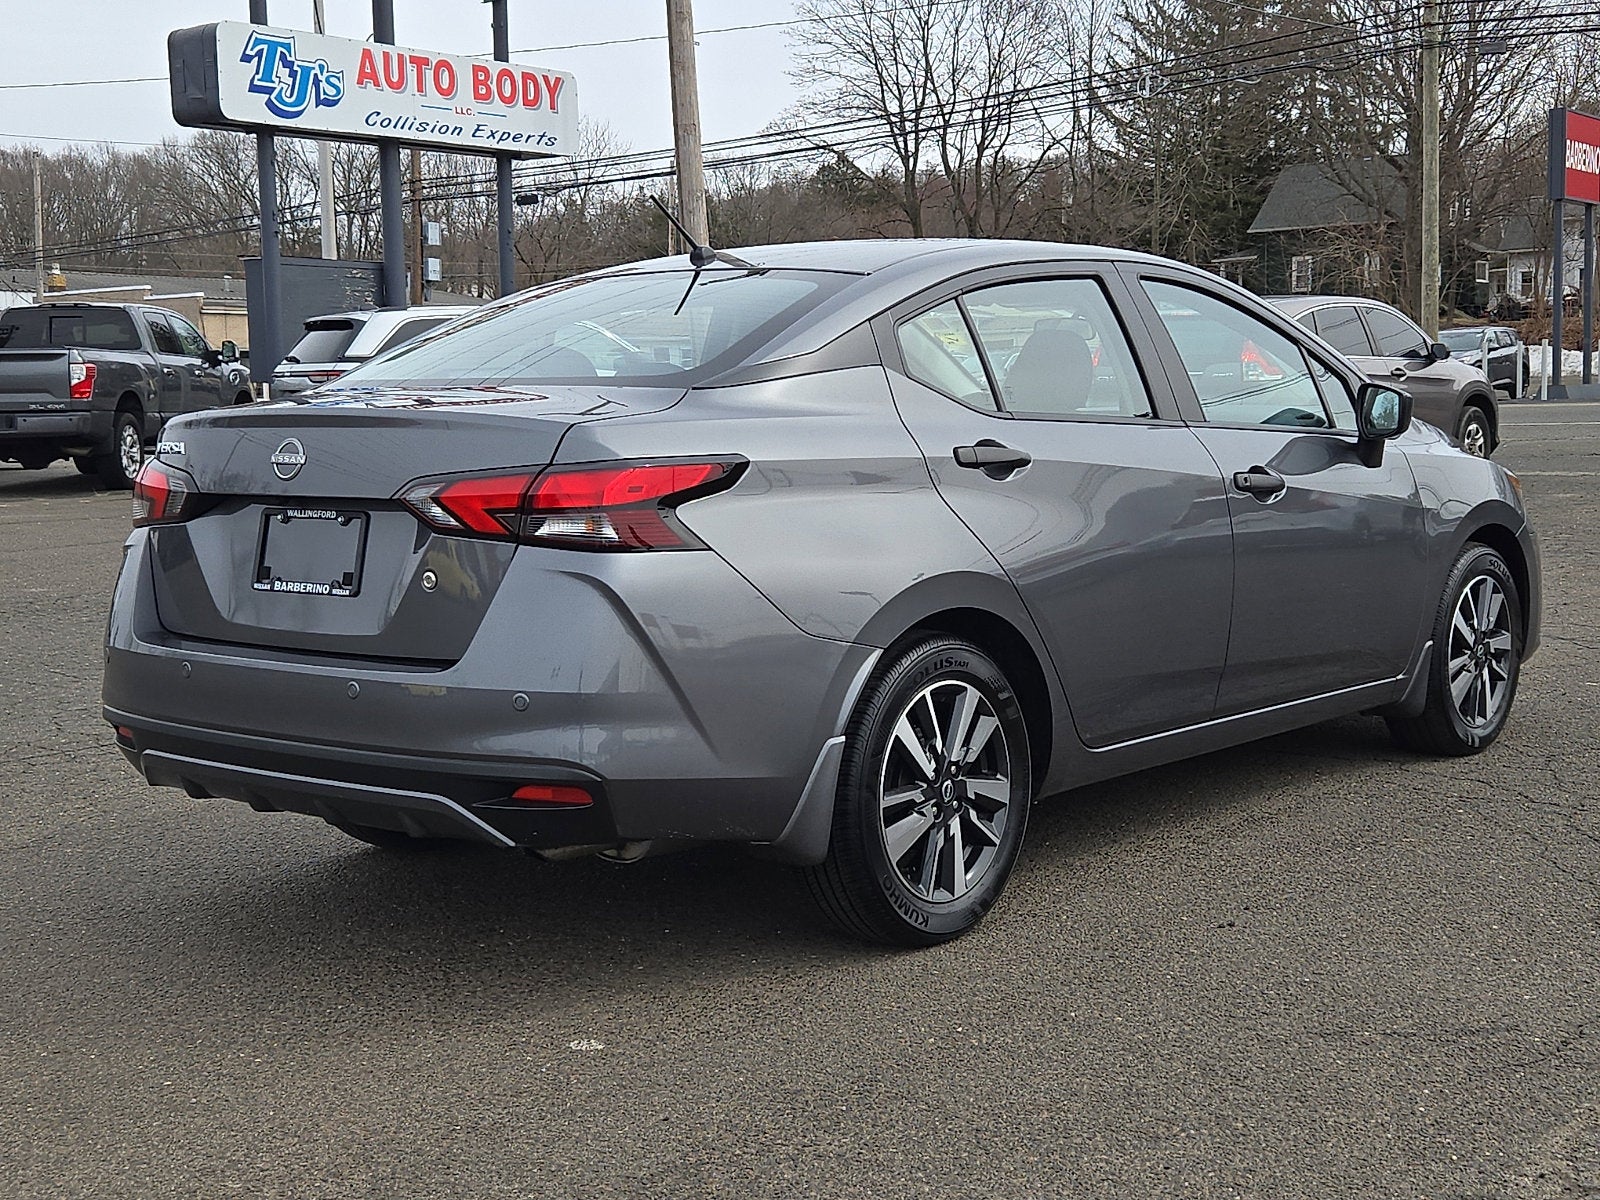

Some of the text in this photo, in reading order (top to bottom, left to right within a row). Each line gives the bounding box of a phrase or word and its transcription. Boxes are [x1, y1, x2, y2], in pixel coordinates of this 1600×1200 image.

[241, 31, 344, 117] TJ's
[356, 48, 563, 112] AUTO BODY
[454, 106, 475, 117] LLC.
[365, 111, 558, 147] Collision Experts
[1566, 139, 1600, 174] BARBERINO
[271, 454, 306, 465] NISSAN
[287, 509, 337, 519] WALLINGFORD
[1488, 559, 1512, 584] SOLUS
[274, 580, 330, 595] BARBERINO
[911, 656, 954, 685] OLUS
[882, 875, 930, 928] KUMHO
